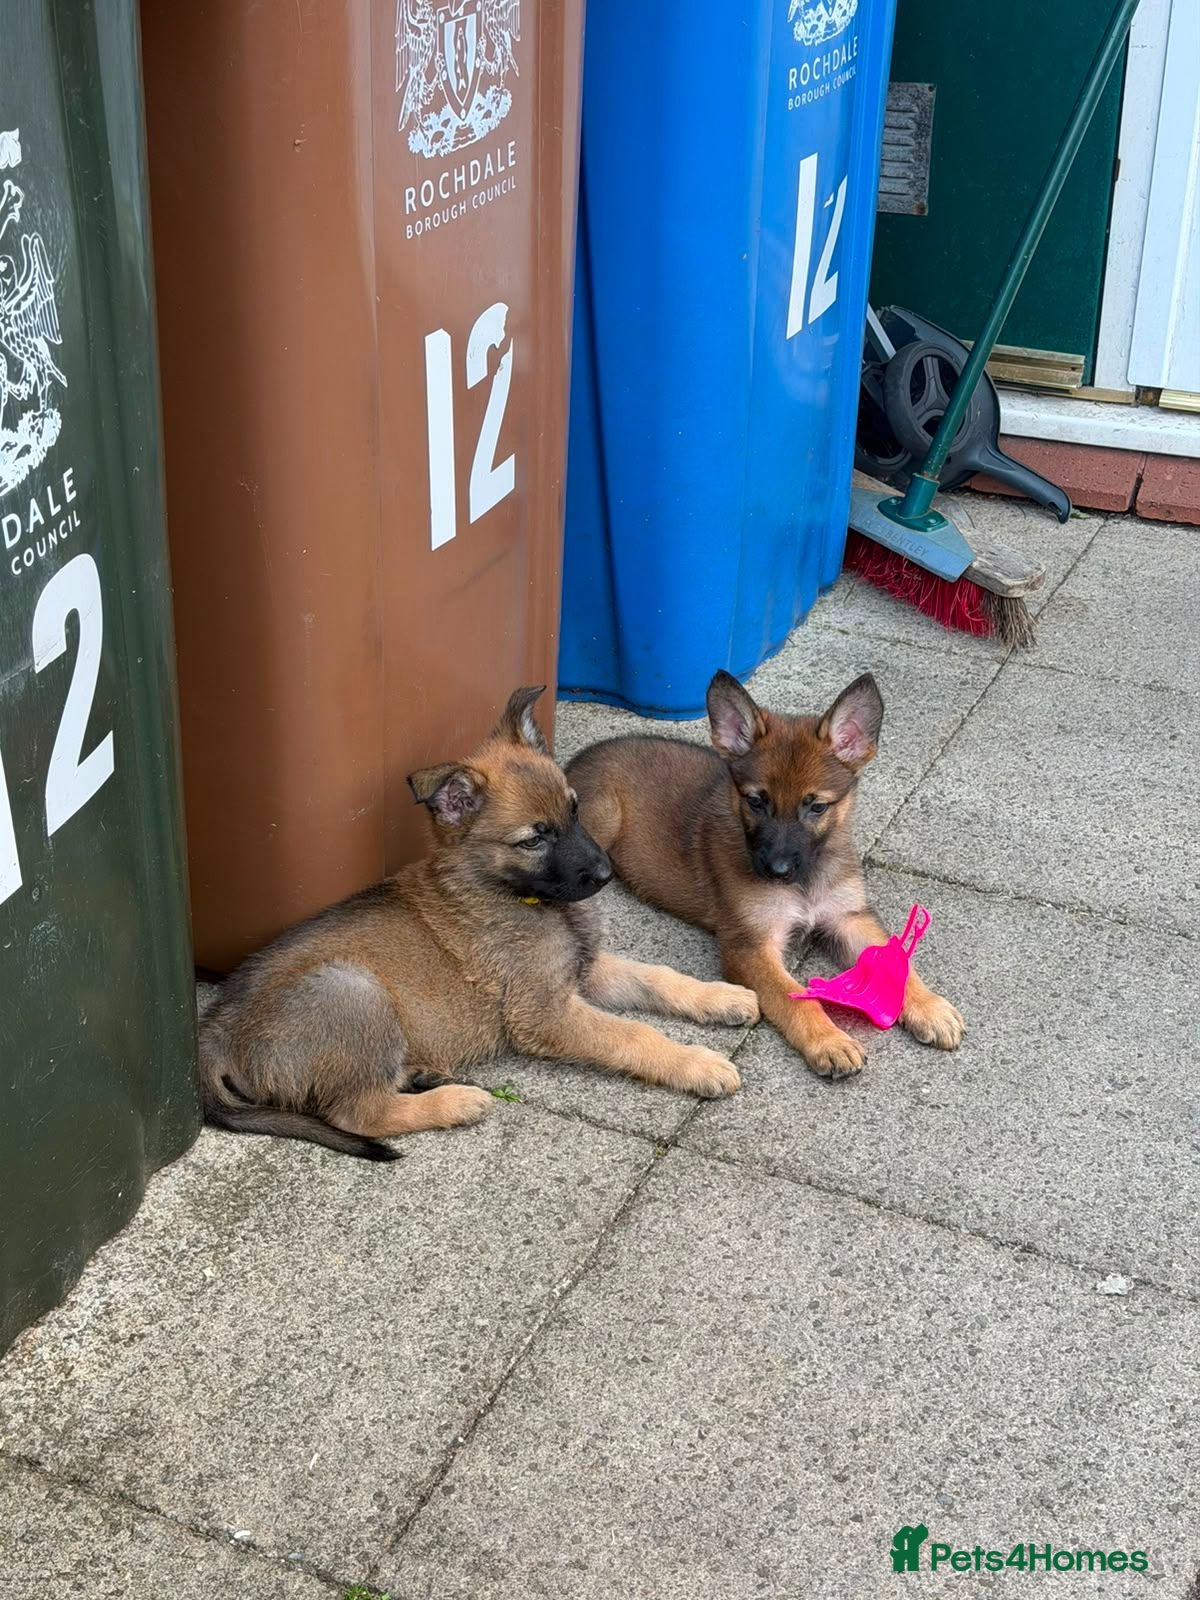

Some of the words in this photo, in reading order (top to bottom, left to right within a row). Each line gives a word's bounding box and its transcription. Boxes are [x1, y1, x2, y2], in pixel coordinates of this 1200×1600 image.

[788, 35, 858, 91] ROCHDALE
[787, 82, 830, 111] BOROUGH
[405, 140, 516, 215] ROCHDALE
[406, 200, 467, 240] BOROUGH
[472, 175, 517, 209] COUNCIL
[424, 302, 516, 551] 12
[1, 467, 77, 549] DALE
[11, 510, 81, 575] COUNCIL
